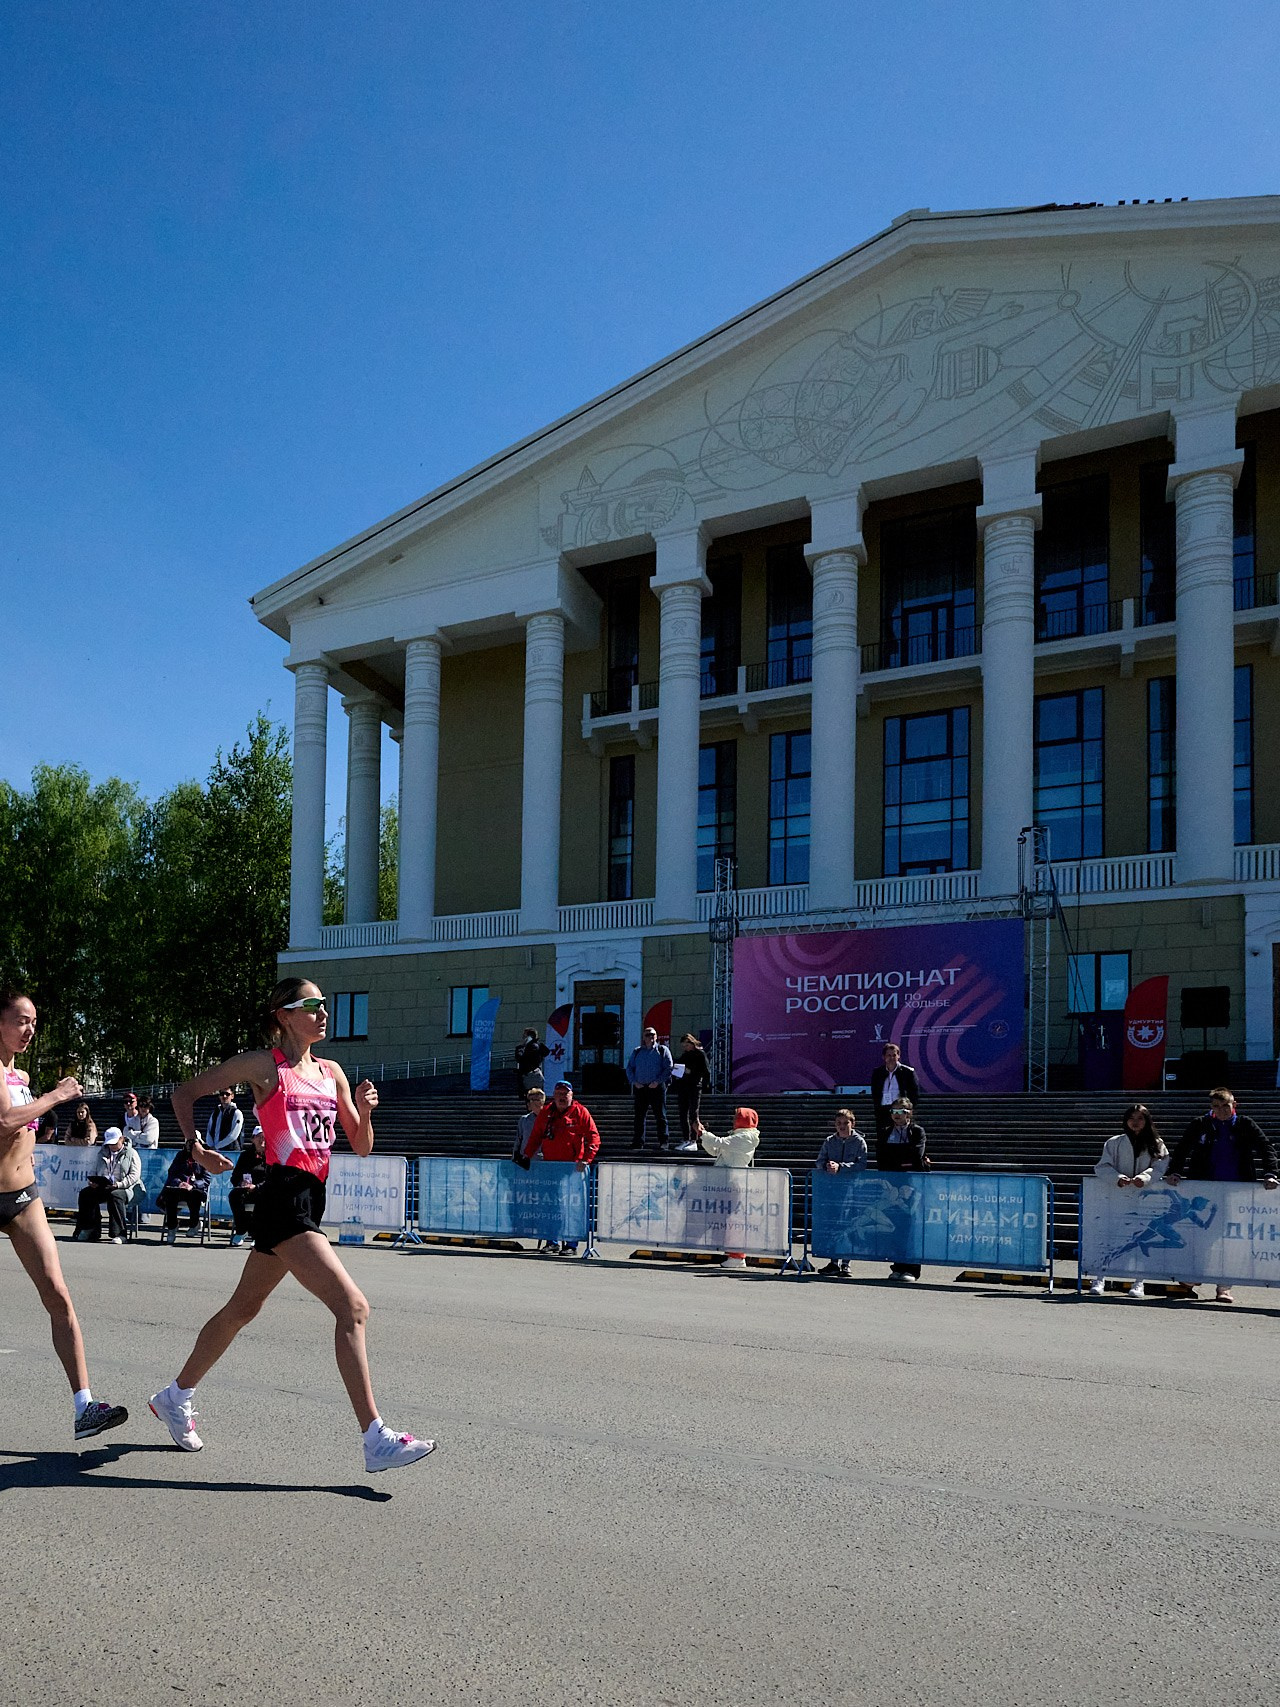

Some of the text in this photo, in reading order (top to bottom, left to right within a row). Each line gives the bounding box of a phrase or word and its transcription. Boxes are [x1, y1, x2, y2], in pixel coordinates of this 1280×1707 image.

[785, 968, 962, 993] ЧЕМПИОНАТ
[785, 993, 898, 1014] РОССИИ
[904, 993, 922, 1001] ПО
[904, 999, 951, 1009] ХОДЬБЕ
[302, 1112, 332, 1143] 126
[330, 1183, 399, 1199] ДИНАМО
[500, 1190, 581, 1207] ДИНАМО
[938, 1193, 1024, 1204] DYNAMO-UDM.RU
[345, 1203, 383, 1212] УДМУРТИЯ
[689, 1199, 780, 1217] ДИНАМО
[519, 1211, 563, 1221] УДМУРТИЯ
[924, 1208, 1038, 1229] ДИНАМО
[707, 1222, 759, 1232] УДМУРТИЯ
[949, 1234, 1012, 1246] УДМУРТИЯ
